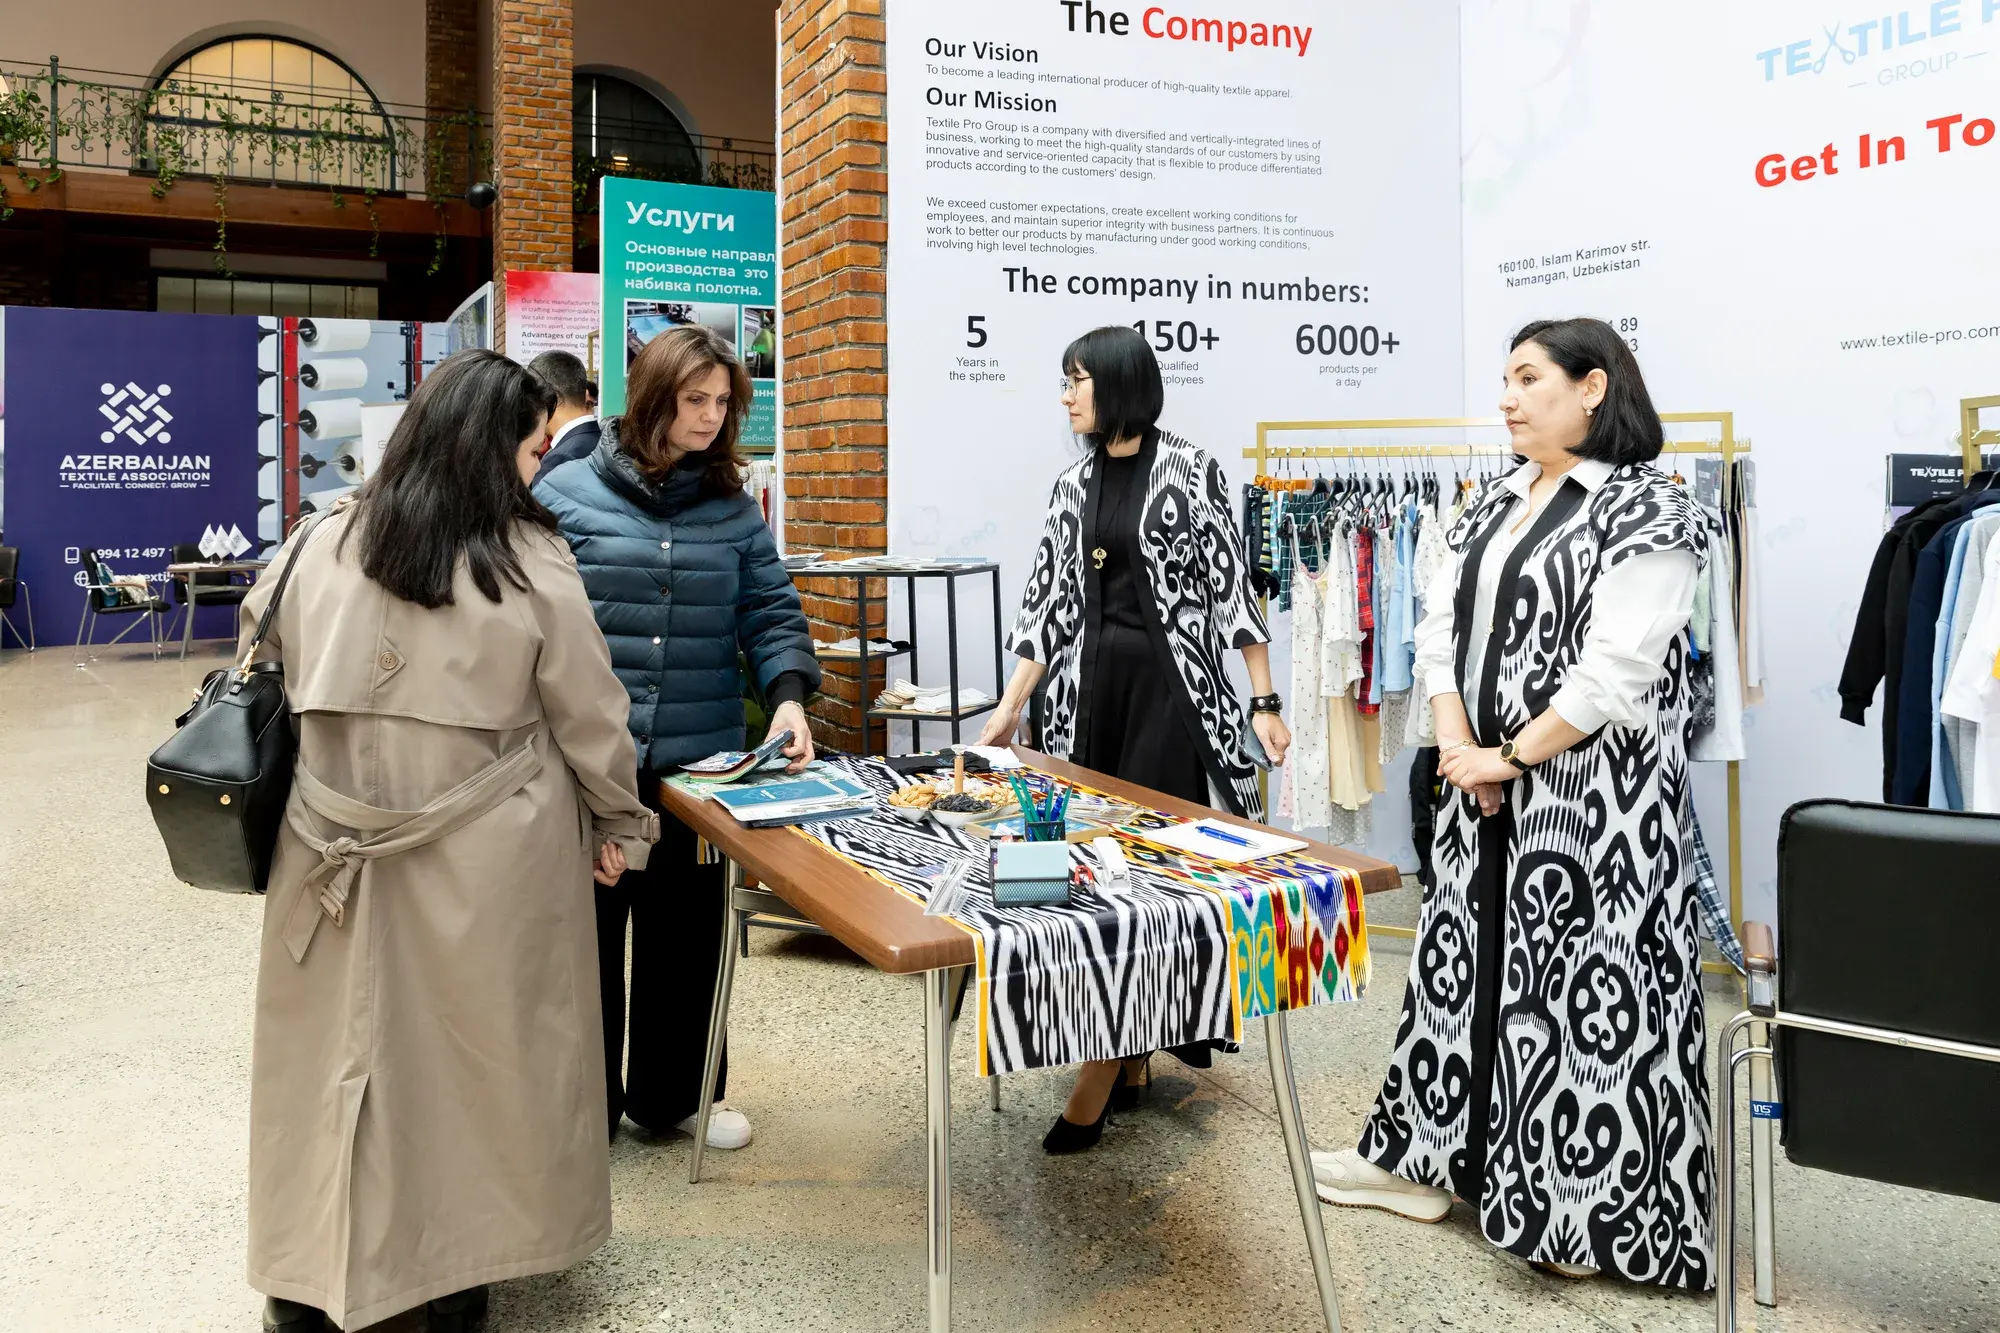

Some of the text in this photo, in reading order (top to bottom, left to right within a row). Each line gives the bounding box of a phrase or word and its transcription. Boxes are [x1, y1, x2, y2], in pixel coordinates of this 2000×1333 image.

[1060, 0, 1312, 57] The Company
[925, 37, 1039, 63] Our Vision
[926, 63, 1292, 99] To become a leading international producer of high-quality textile apparel.
[1877, 51, 1958, 86] GROUP
[926, 87, 1057, 113] Our Mission
[926, 116, 1320, 150] Textile Pro Group is a company with diversified and vertically-integrated lines of
[926, 130, 1320, 164] business, working to meet the high-quality standards of our customers by using
[927, 143, 1321, 176] innovative and service-oriented capacity that is flexible to produce differentiated
[1755, 113, 1996, 187] Get In To
[927, 158, 1155, 182] products according to the customers' design.
[626, 200, 735, 234] Услуги
[927, 196, 1297, 224] We exceed customer expectations, create excellent working conditions for
[927, 210, 1334, 238] employees, and maintain superior integrity with business partners. It is continuous
[625, 240, 707, 258] Основные
[927, 224, 1309, 251] work to better our products by manufacturing under good working conditions,
[927, 237, 1097, 257] involving high level technologies.
[625, 260, 769, 280] производства это
[1498, 239, 1651, 275] 160100, Islam Karimov str.
[1002, 266, 1369, 304] The company in numbers:
[1506, 258, 1641, 288] Namangan, Uzbekistan
[624, 277, 762, 296] набивка полотна.
[521, 331, 563, 339] Advantages
[966, 315, 987, 348] 5
[1133, 320, 1219, 352] 150+
[1620, 317, 1638, 332] 89
[1295, 324, 1400, 356] 6000+
[956, 357, 999, 367] Years in
[1157, 361, 1199, 371] Qualified
[1319, 364, 1377, 375] products per
[949, 371, 1006, 383] the sphere
[1160, 374, 1204, 386] ployees
[1335, 377, 1361, 389] a day
[752, 389, 775, 397] анн
[60, 455, 210, 470] AZERBAIJAN
[1910, 466, 1955, 478] TEXTILE
[60, 472, 210, 481] TEXTILE ASSOCIATION
[124, 548, 139, 559] 12
[142, 547, 165, 558] 497
